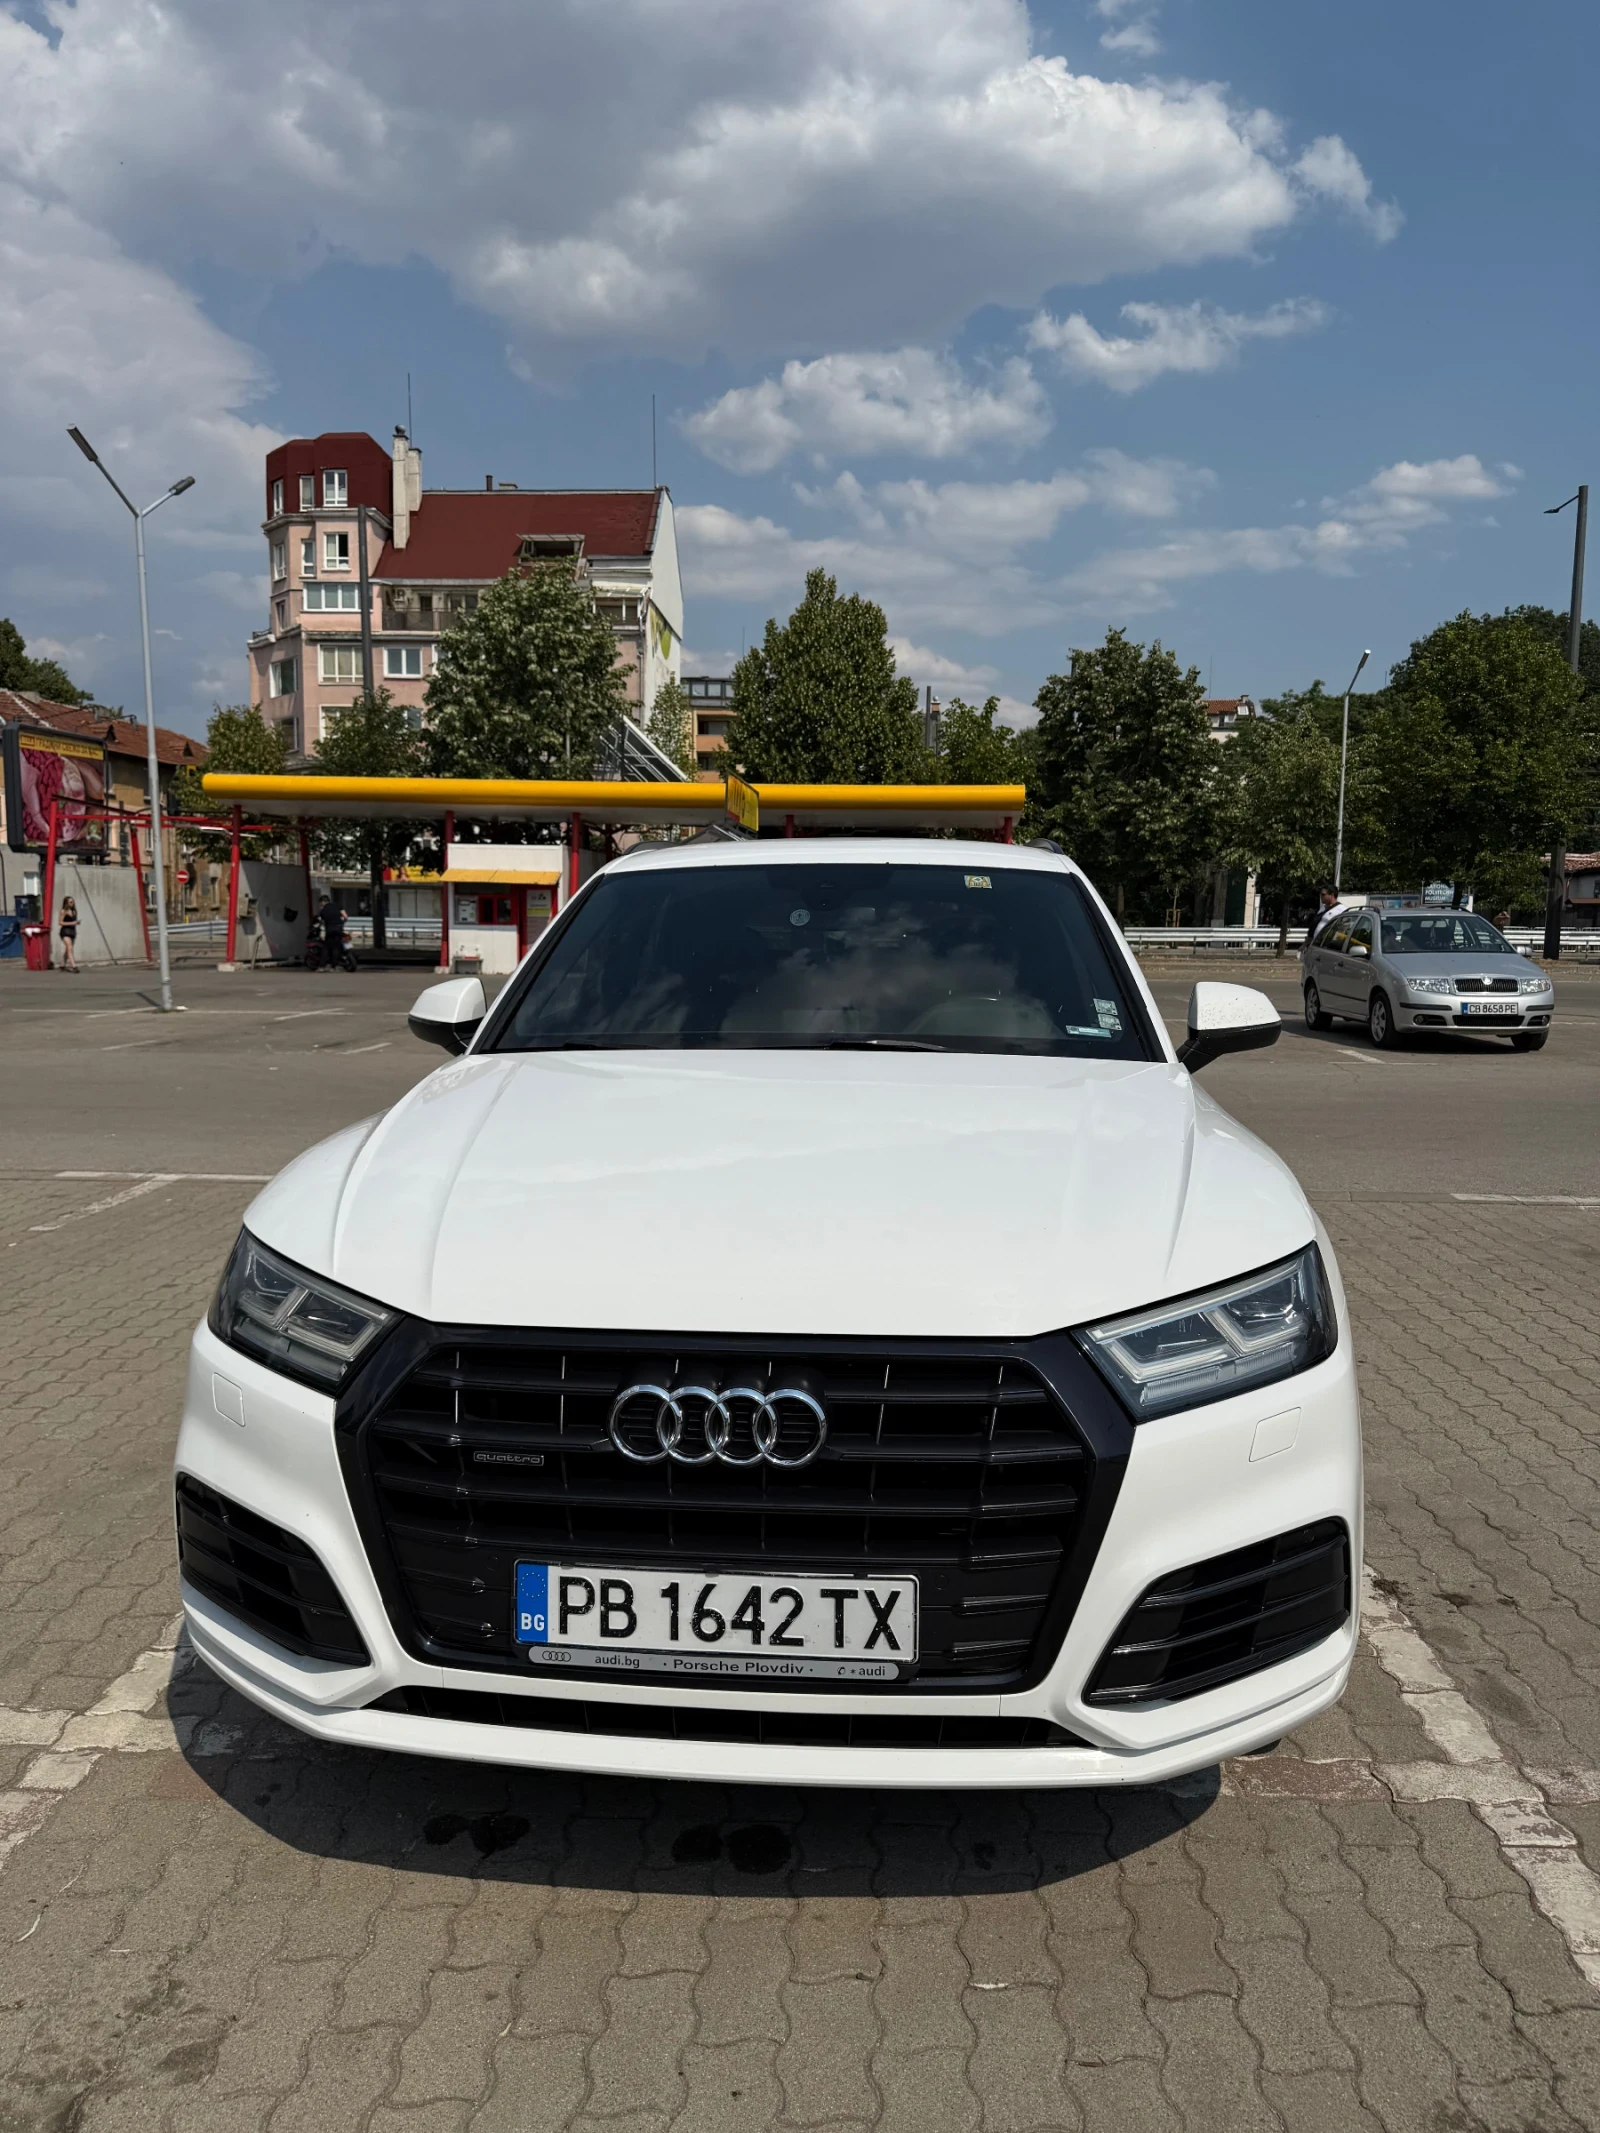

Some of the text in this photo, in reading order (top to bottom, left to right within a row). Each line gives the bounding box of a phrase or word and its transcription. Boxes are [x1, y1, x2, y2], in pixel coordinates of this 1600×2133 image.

[1469, 1004, 1481, 1013] CB
[1482, 1004, 1504, 1013] 8658
[1505, 1004, 1516, 1013] PE
[476, 1453, 540, 1463] quattro
[521, 1612, 545, 1631] BG
[559, 1575, 902, 1650] PB 1642 TX
[594, 1654, 640, 1669] audi.bg
[673, 1659, 740, 1672] Porsche
[745, 1661, 804, 1674] Plovdiv
